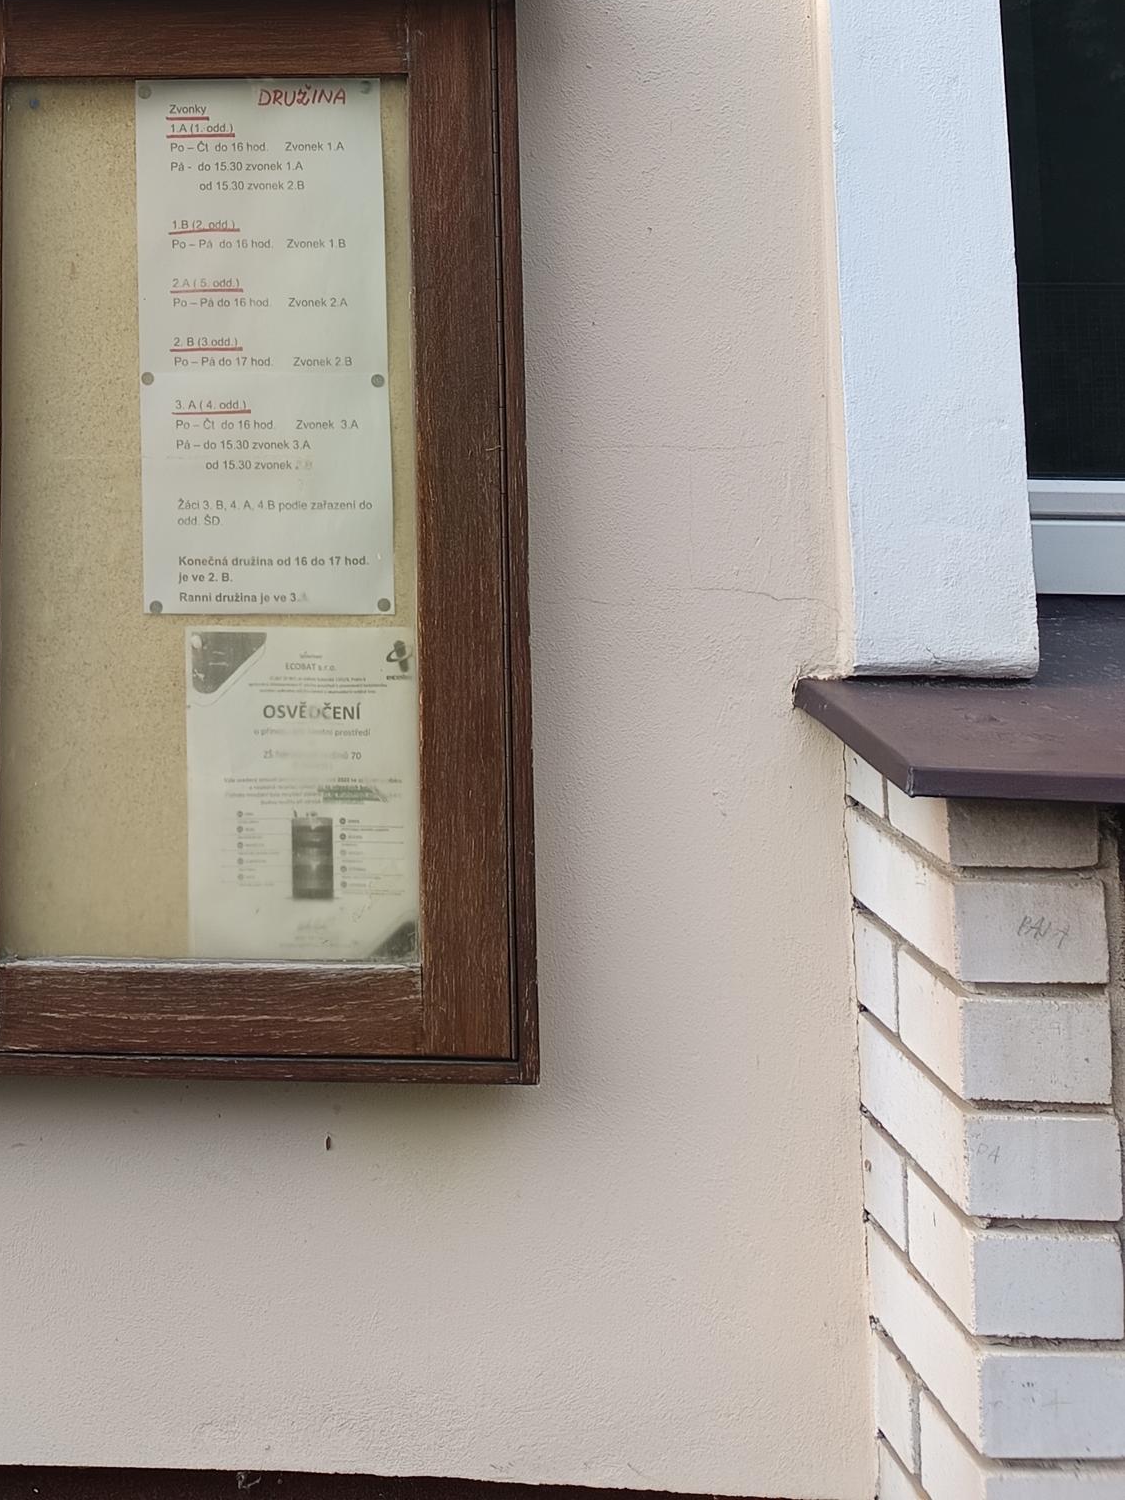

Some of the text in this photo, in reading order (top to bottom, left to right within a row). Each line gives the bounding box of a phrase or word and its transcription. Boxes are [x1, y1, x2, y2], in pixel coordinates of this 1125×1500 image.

[258, 84, 346, 107] DRUŽINA
[169, 104, 207, 115] Zvonky
[171, 124, 233, 133] 1.A (1. odd.)
[171, 142, 185, 152] Po
[197, 141, 208, 152] Čt
[215, 142, 228, 152] do
[231, 142, 243, 152] 16
[246, 142, 268, 152] hod.
[285, 142, 323, 152] Zvonek
[327, 142, 345, 152] 1.A
[171, 162, 184, 172] Pá
[198, 162, 211, 172] do
[214, 162, 243, 172] 15.30
[245, 162, 282, 172] zvonek
[286, 162, 303, 172] 1.A
[199, 181, 305, 191] od 15.30 zvonek 2.B
[172, 220, 235, 229] 1.B (2. odd.)
[172, 239, 186, 249] Po
[199, 239, 212, 249] Pá
[219, 239, 232, 249] do
[236, 239, 248, 249] 16
[251, 239, 274, 249] hod.
[286, 239, 325, 249] Zvonek
[329, 239, 346, 249] 1.B
[173, 278, 190, 288] 2.A
[213, 278, 240, 288] odd.)
[173, 298, 187, 307] Po
[200, 298, 214, 307] Pá
[217, 298, 230, 307] do
[234, 298, 246, 307] 16
[249, 298, 272, 307] hod.
[288, 298, 327, 307] Zvonek
[330, 298, 348, 307] 2.A
[174, 337, 183, 347] 2.
[186, 337, 194, 347] B
[174, 357, 189, 367] Po
[201, 357, 215, 367] Pá
[218, 357, 232, 367] do
[235, 357, 247, 367] 17
[250, 357, 273, 367] hod.
[293, 357, 331, 367] Zvonek
[335, 357, 353, 367] 2.B
[175, 400, 184, 410] 3.
[188, 400, 197, 410] A
[206, 400, 216, 410] 4.
[219, 400, 246, 410] odd.)
[175, 420, 190, 430] Po
[203, 418, 215, 430] Čt
[221, 420, 234, 430] do
[238, 420, 250, 430] 16
[295, 420, 334, 430] Zvonek
[340, 420, 359, 430] 3.A
[176, 440, 190, 450] Pá
[203, 440, 217, 450] do
[220, 440, 249, 450] 15.30
[252, 440, 290, 450] zvonek
[293, 440, 311, 450] 3.A
[205, 460, 219, 470] od
[222, 460, 251, 470] 15.30
[254, 460, 292, 470] zvonek
[178, 498, 200, 510] Žáci
[203, 500, 213, 510] 3.
[215, 500, 226, 512] B,
[230, 500, 240, 510] 4.
[278, 500, 308, 513] podle
[359, 500, 373, 510] do
[178, 517, 200, 526] odd.
[179, 556, 370, 566] Konečná družina od 16 do 17 hod.
[178, 573, 189, 584] je
[208, 573, 218, 582] 2.
[221, 573, 233, 582] B.
[179, 593, 212, 602] Ranní
[215, 593, 257, 602] družina
[260, 593, 271, 605] je
[263, 702, 361, 720] OSVĚDČENÍ
[335, 729, 371, 738] prostředí
[351, 752, 361, 760] 70
